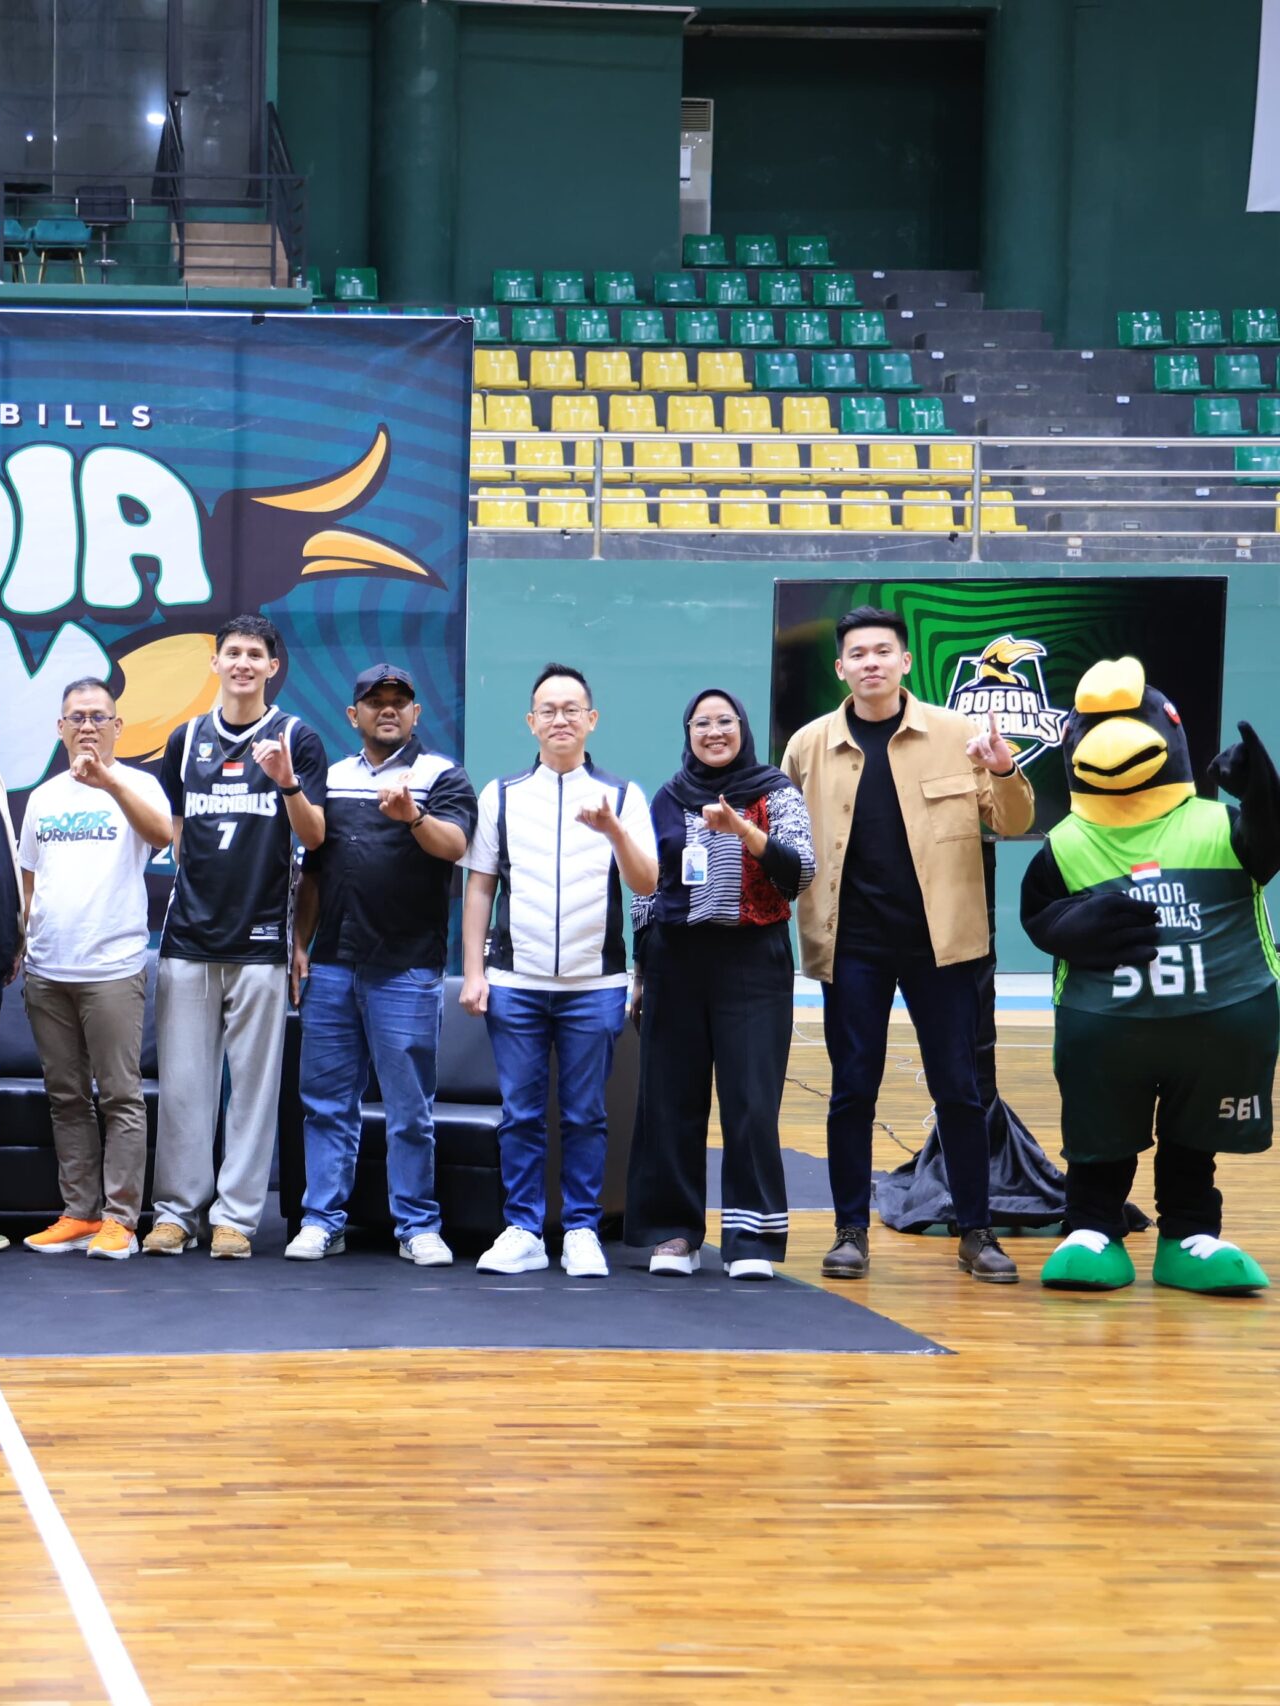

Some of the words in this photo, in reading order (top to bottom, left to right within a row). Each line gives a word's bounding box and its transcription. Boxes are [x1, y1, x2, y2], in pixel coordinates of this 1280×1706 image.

[956, 690, 1039, 714] BOGOR
[211, 783, 249, 796] BOGOR
[184, 791, 277, 818] HORNBILLS
[39, 810, 112, 833] BOGOR
[35, 826, 118, 843] HORNBILLS
[217, 821, 238, 850] 7
[1122, 882, 1187, 904] OGOR
[1112, 943, 1208, 998] 561
[1218, 1095, 1261, 1121] 561
